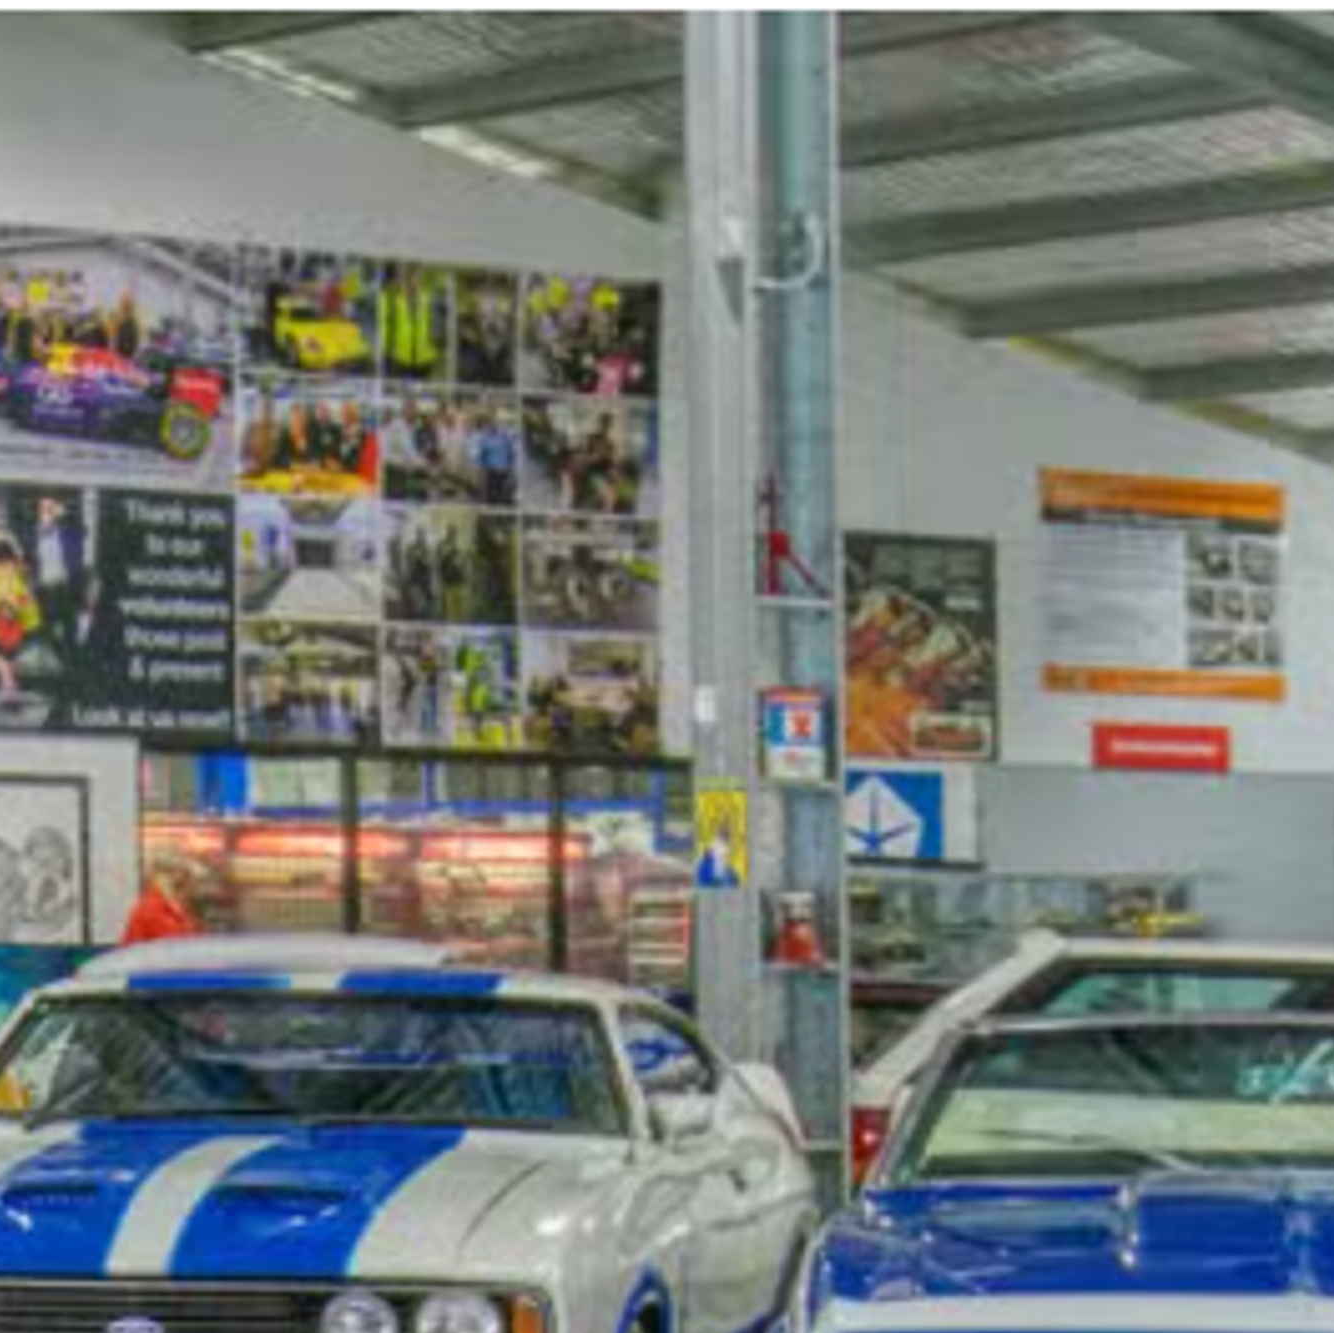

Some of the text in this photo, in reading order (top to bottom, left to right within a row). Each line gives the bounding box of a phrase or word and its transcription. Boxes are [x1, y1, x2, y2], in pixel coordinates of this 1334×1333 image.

[124, 500, 226, 530] Thank you
[127, 566, 225, 587] wonderful
[73, 702, 119, 727] Look
